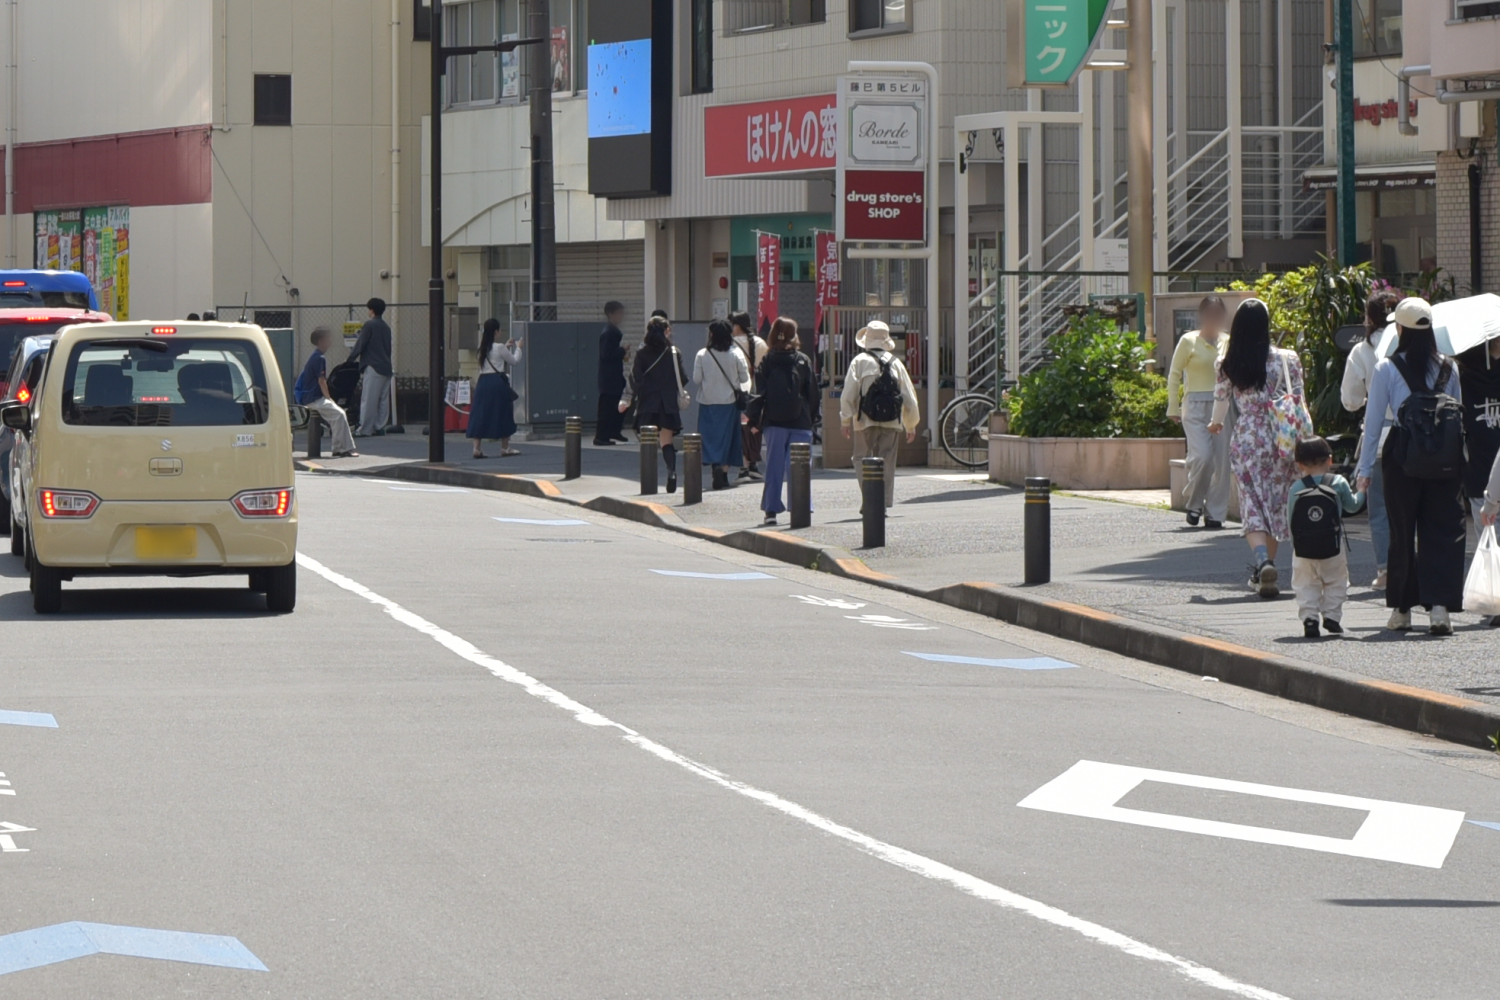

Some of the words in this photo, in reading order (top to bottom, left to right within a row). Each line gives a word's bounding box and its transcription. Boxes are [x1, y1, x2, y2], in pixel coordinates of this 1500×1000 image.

[859, 120, 911, 139] Borde
[847, 190, 877, 204] drug
[879, 191, 922, 204] store's
[868, 208, 901, 219] SHOP
